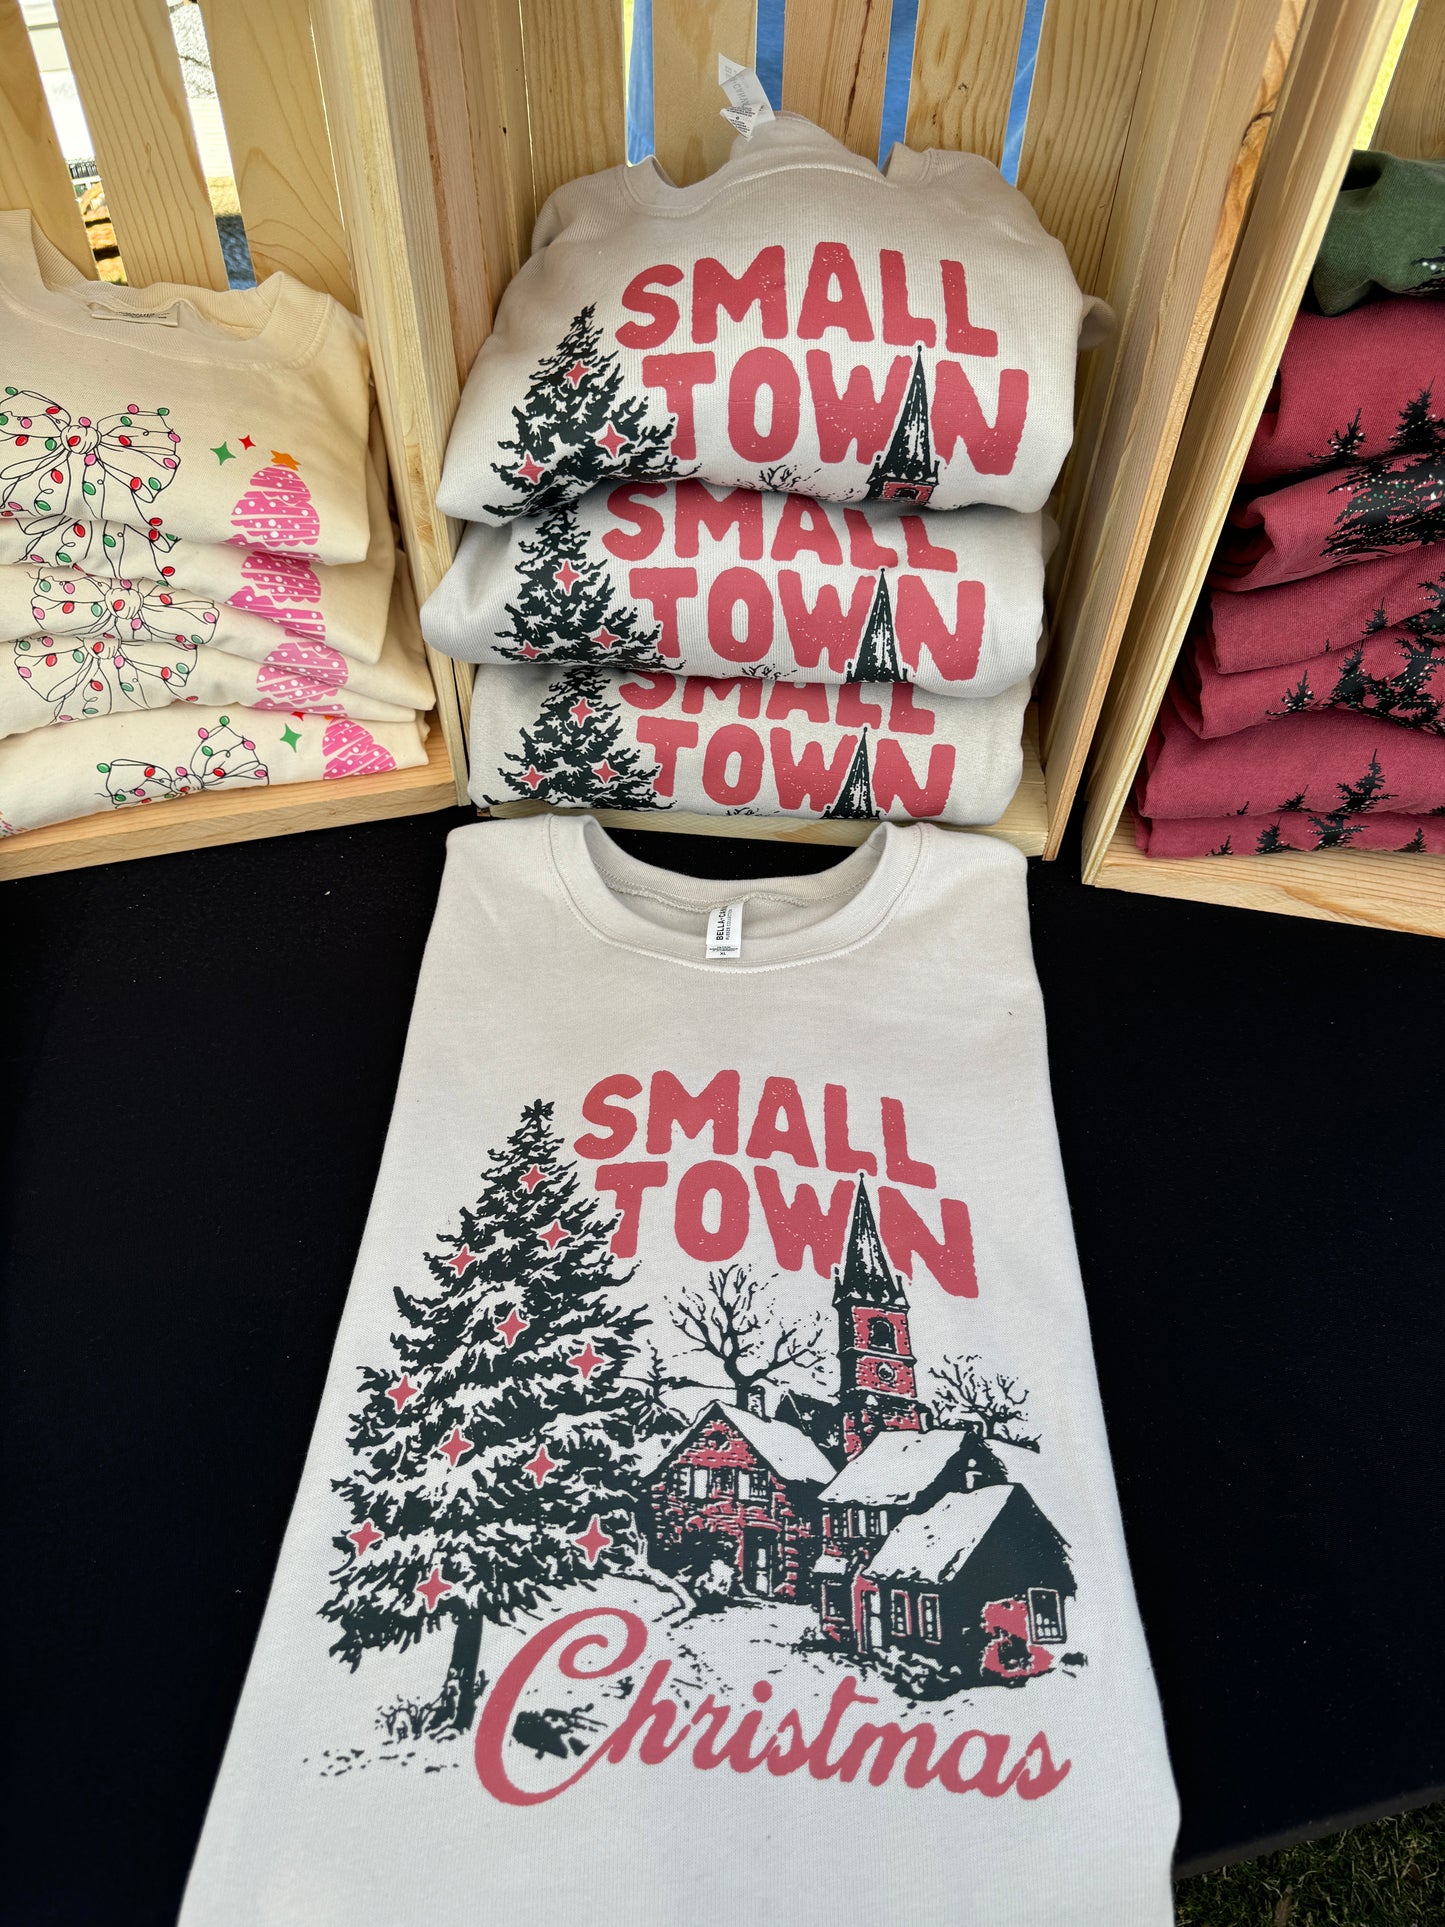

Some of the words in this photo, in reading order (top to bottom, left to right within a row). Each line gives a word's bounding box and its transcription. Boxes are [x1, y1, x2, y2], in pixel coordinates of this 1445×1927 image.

[614, 241, 999, 358] SMALL
[641, 346, 1029, 476] TOWN
[601, 482, 958, 574] SMALL
[628, 566, 986, 682] TOWN
[636, 715, 957, 819] TOWN
[573, 1069, 937, 1189] SMALL
[594, 1160, 979, 1299] TOWN
[475, 1607, 1071, 1806] Christmas
